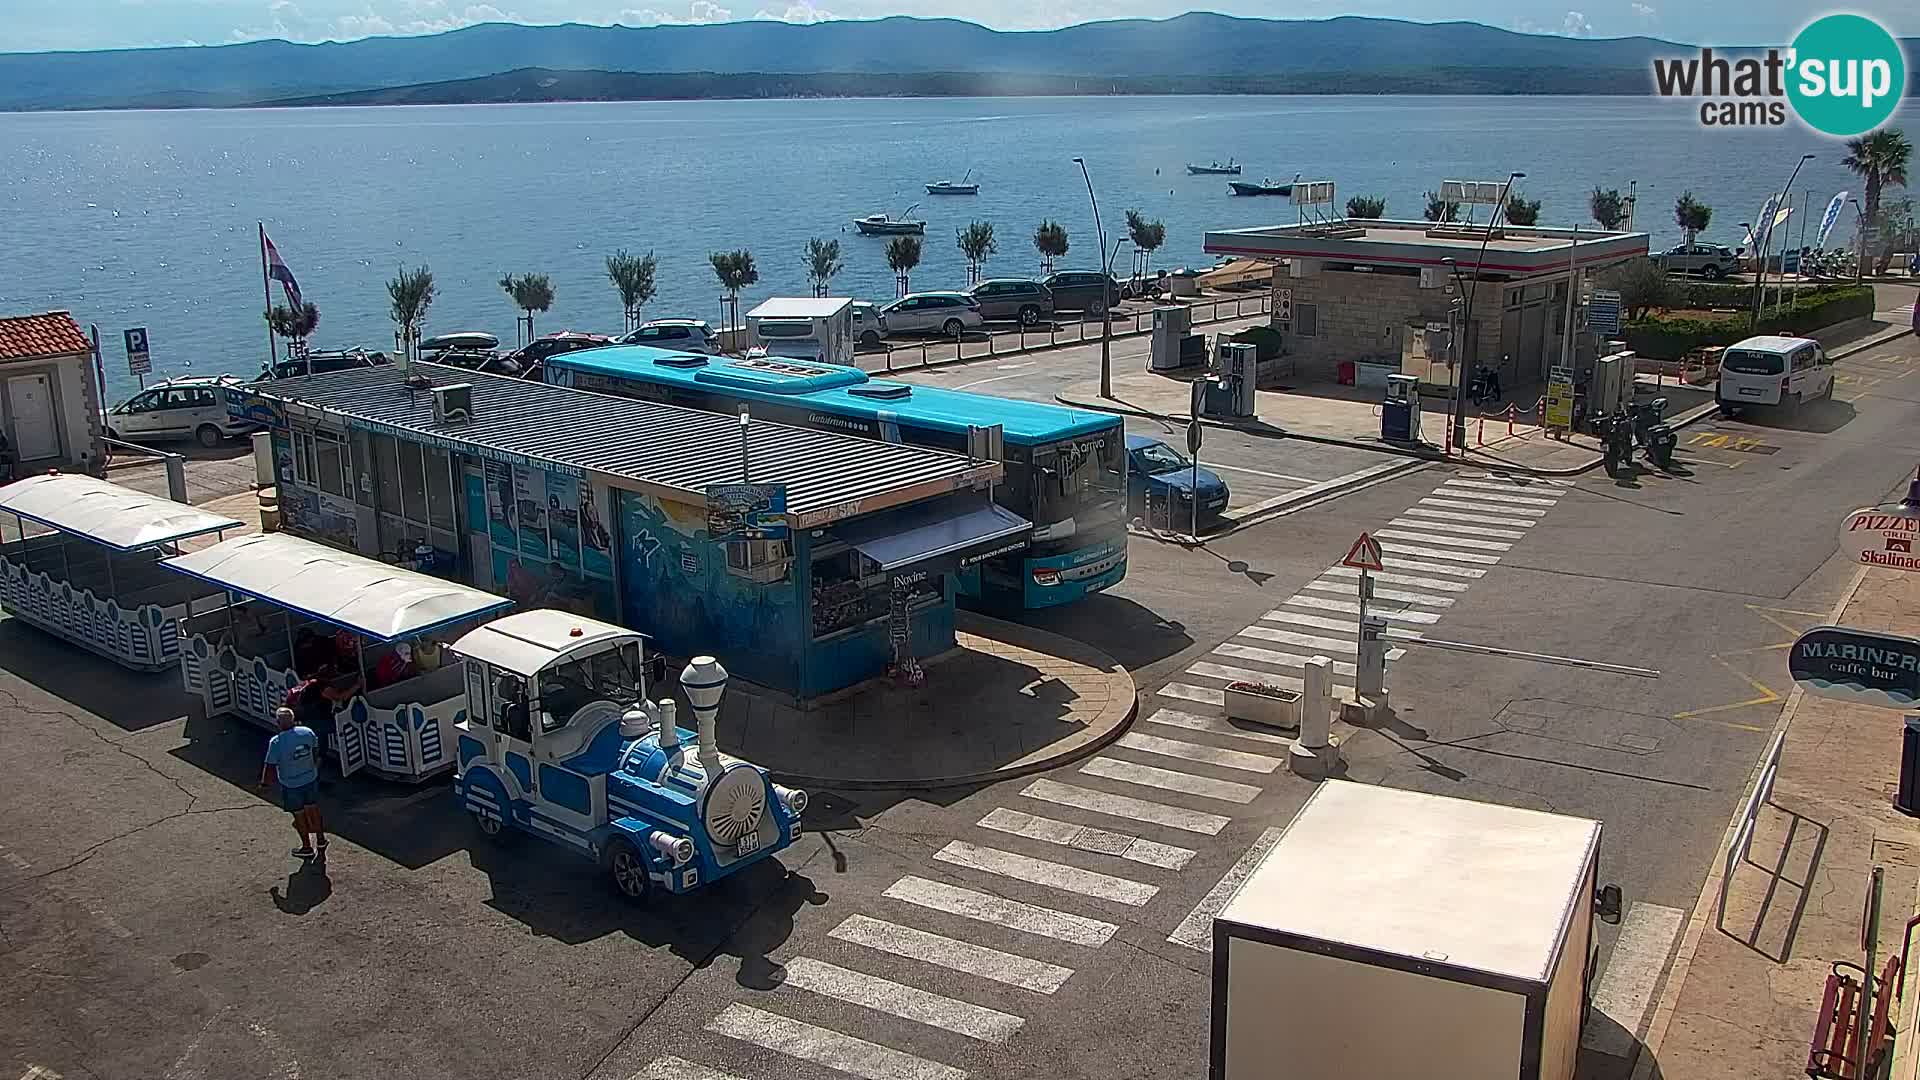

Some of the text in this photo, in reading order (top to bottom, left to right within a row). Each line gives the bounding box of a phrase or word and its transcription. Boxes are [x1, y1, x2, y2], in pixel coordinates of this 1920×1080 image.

[130, 332, 142, 350] P
[436, 439, 468, 453] POSTAJA
[478, 446, 493, 459] BUS
[494, 449, 526, 466] STATION
[529, 457, 556, 473] TICKET
[555, 460, 583, 478] OFFICE
[1849, 516, 1920, 534] PIZZE
[1829, 661, 1899, 681] caffe bar
